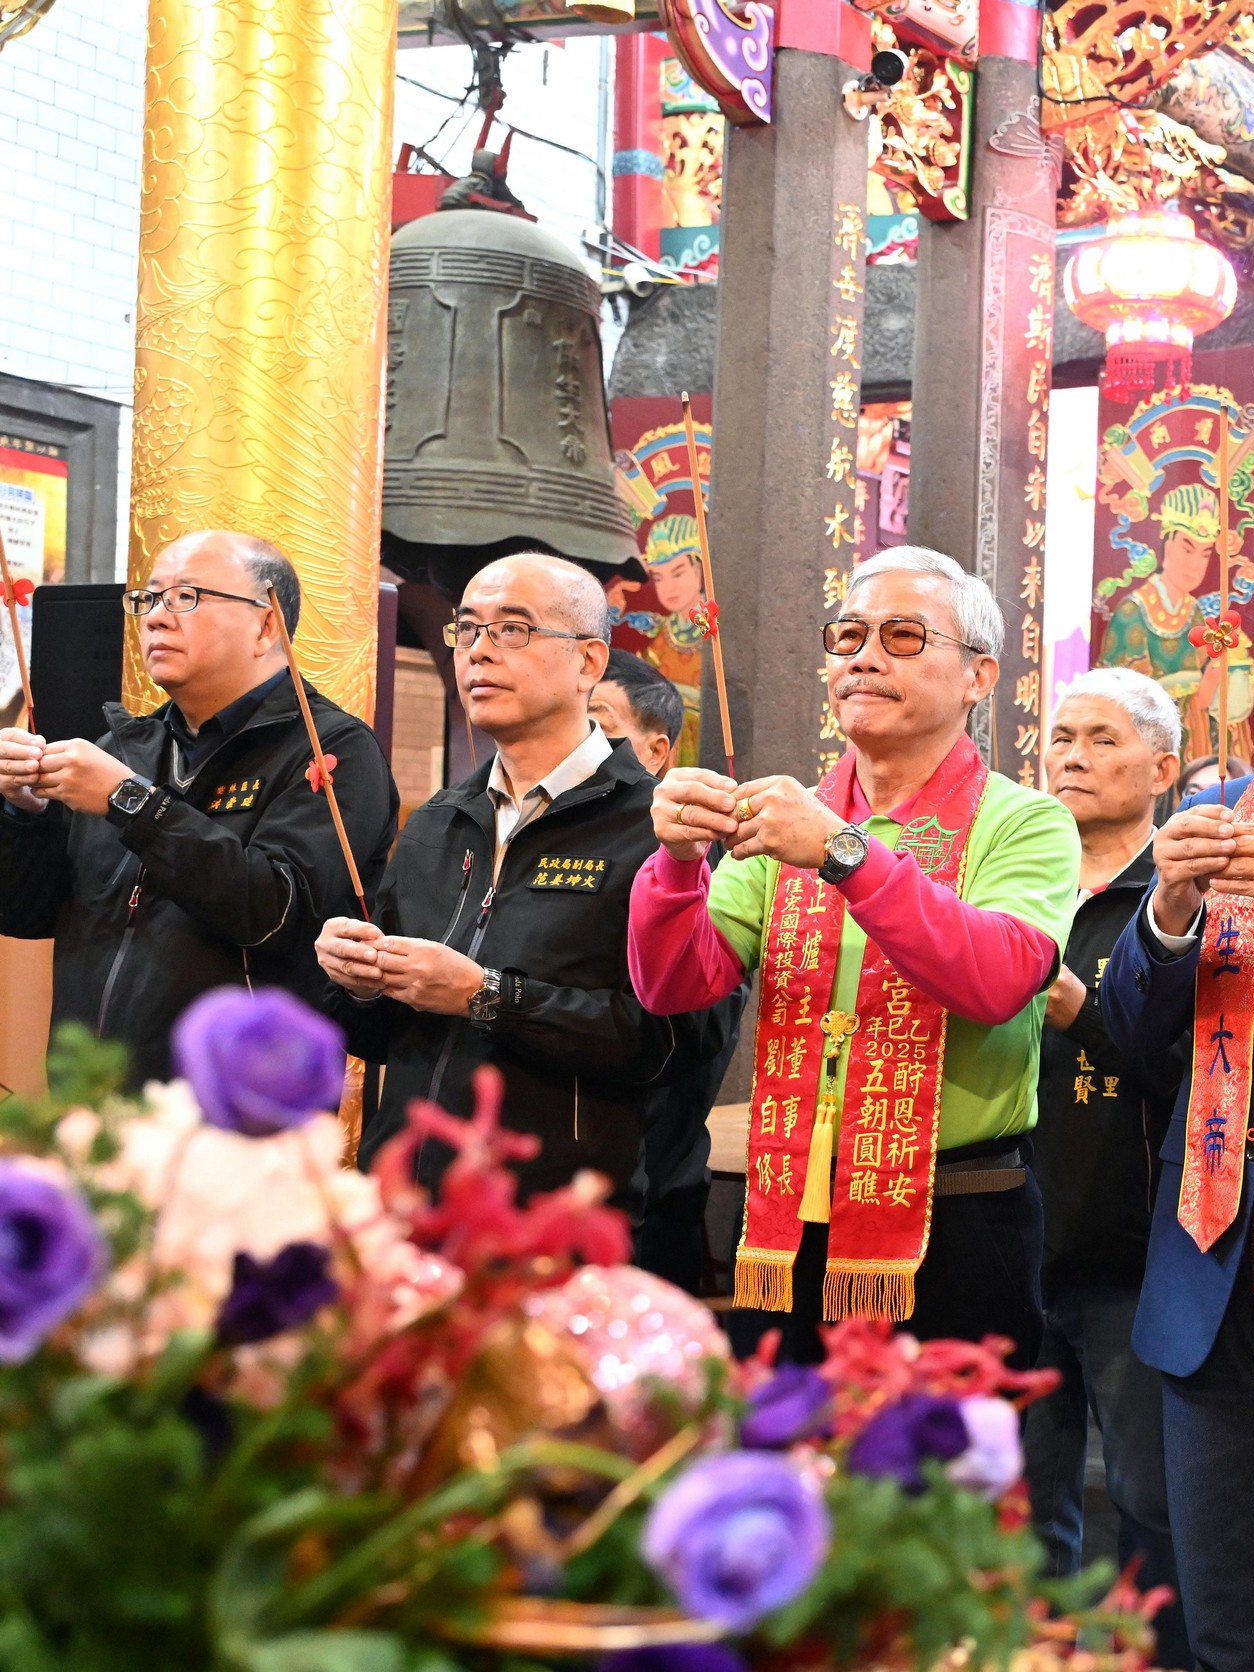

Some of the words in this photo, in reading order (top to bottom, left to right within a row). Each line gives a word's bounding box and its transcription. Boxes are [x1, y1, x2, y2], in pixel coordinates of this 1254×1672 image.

[537, 857, 605, 871] 民政局副局長
[532, 872, 597, 888] 范姜坤火
[865, 1042, 927, 1059] 2025
[849, 1059, 889, 1206] 五朝圓醮
